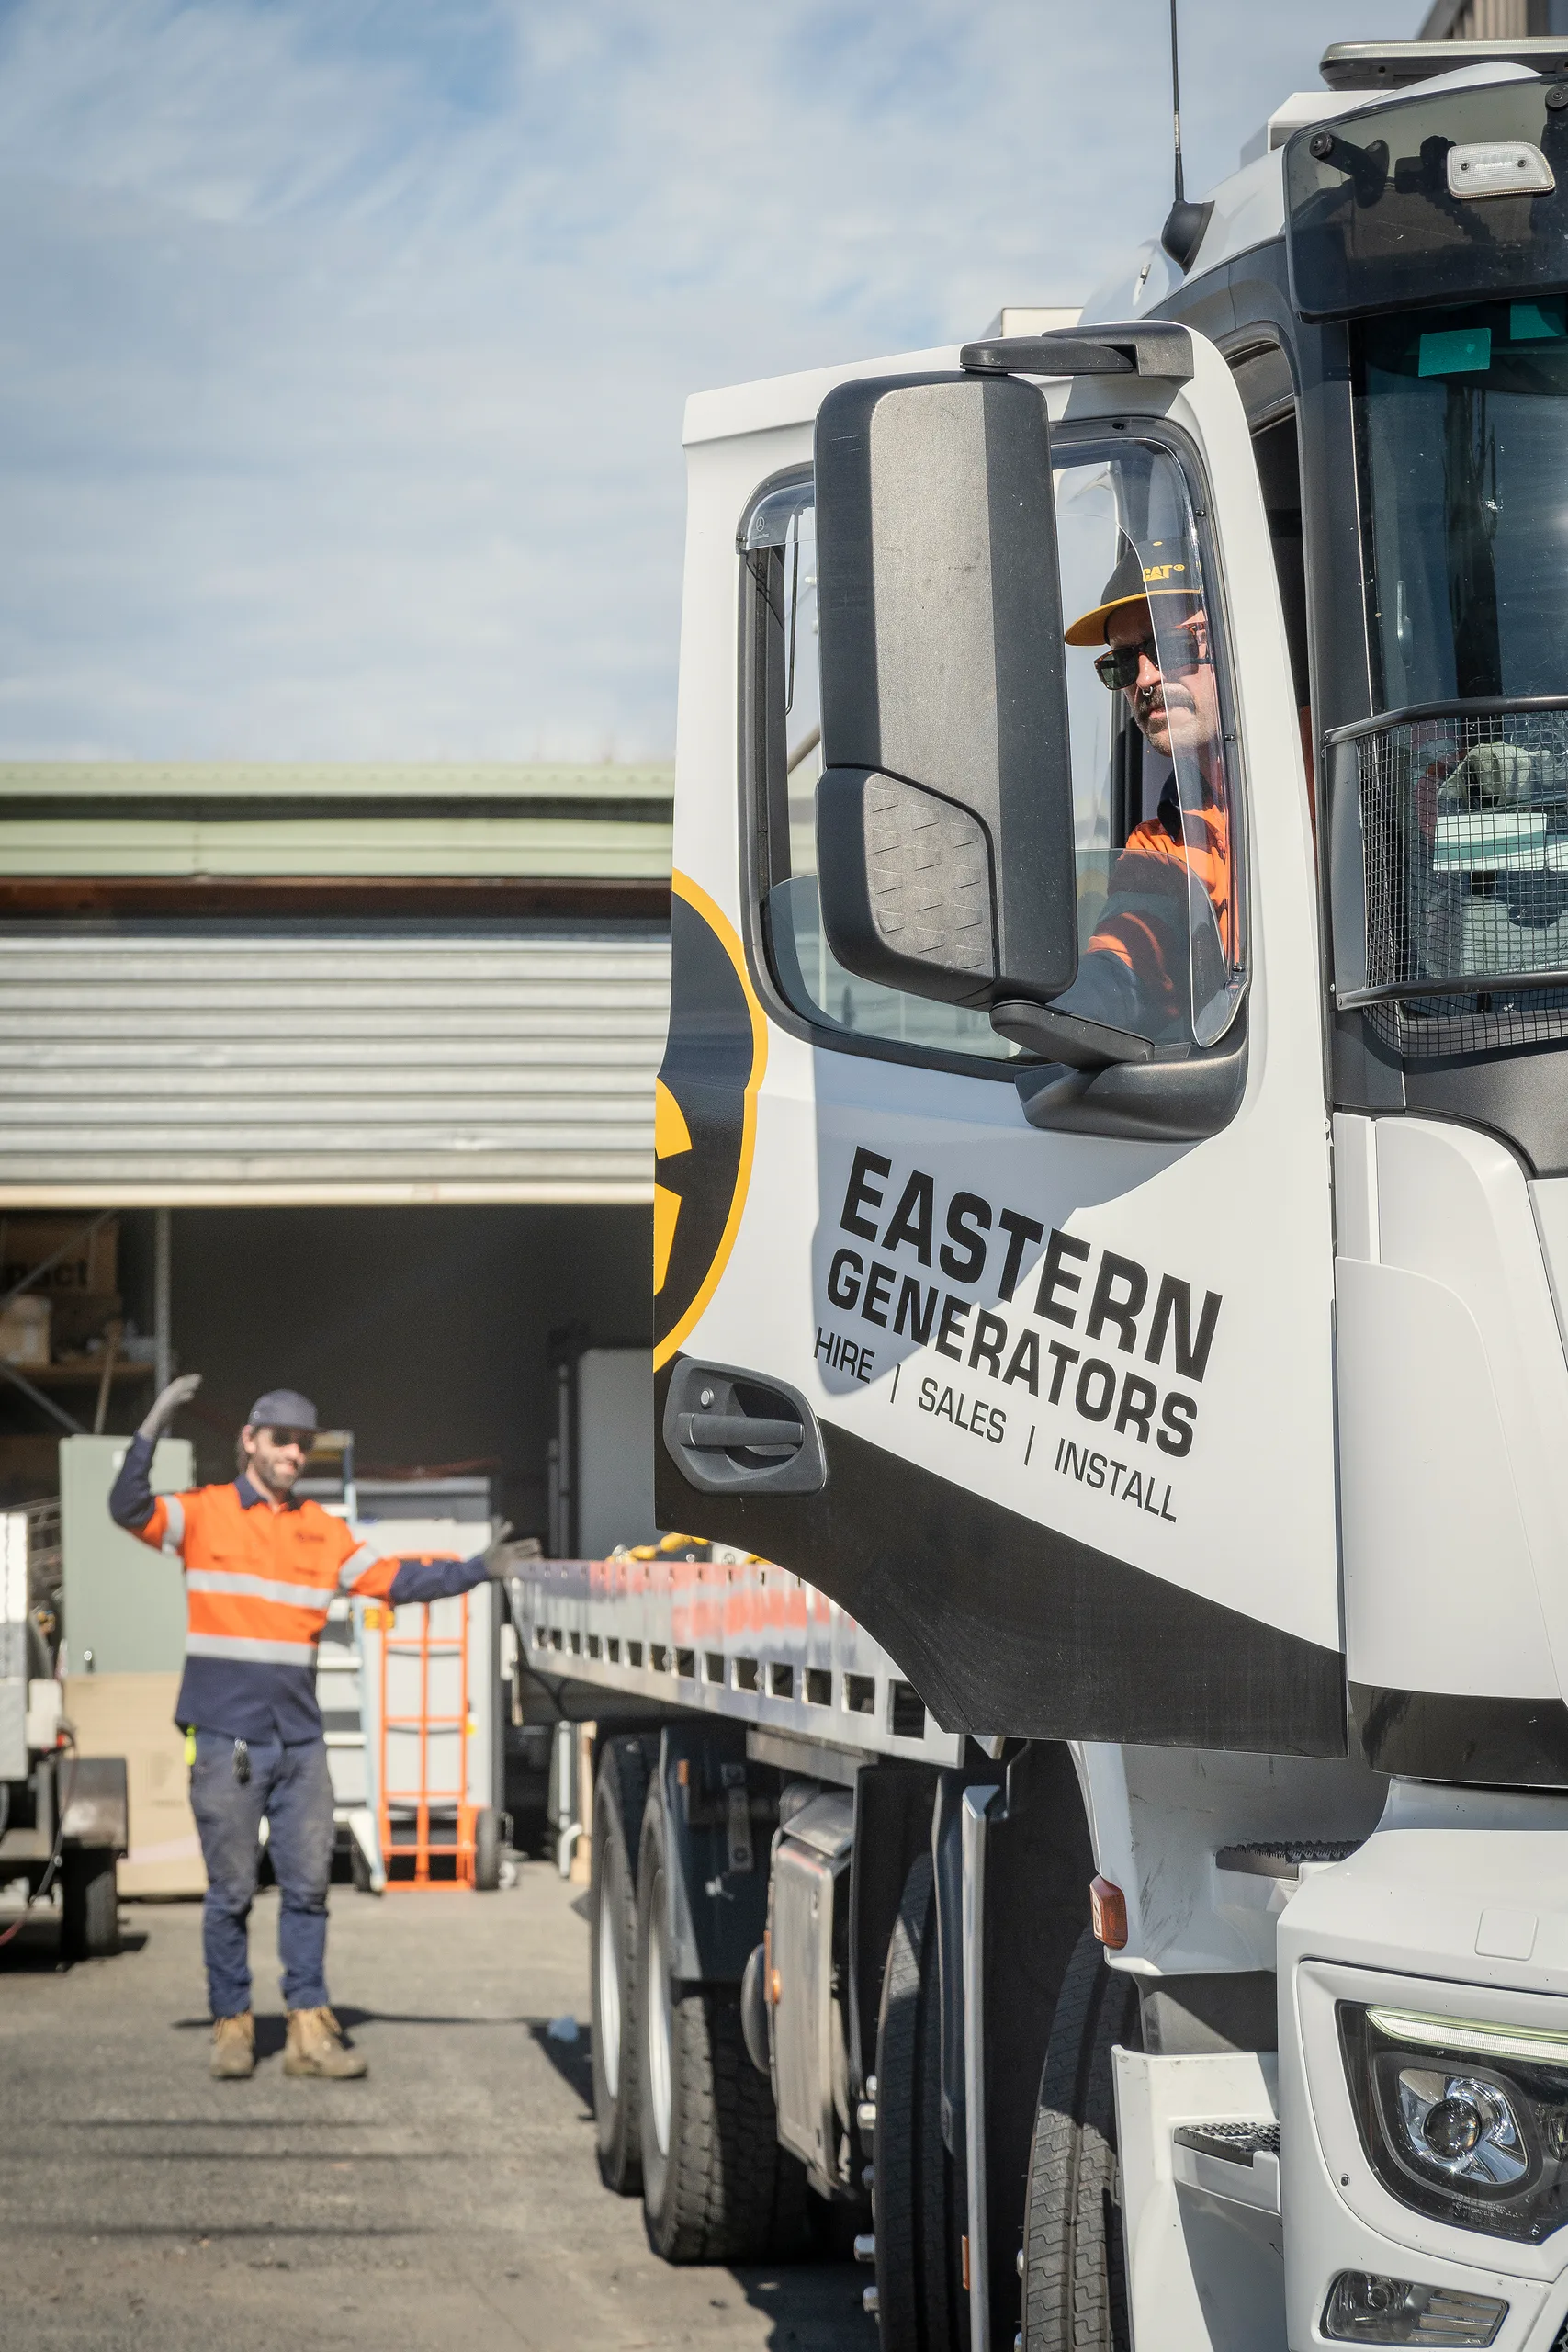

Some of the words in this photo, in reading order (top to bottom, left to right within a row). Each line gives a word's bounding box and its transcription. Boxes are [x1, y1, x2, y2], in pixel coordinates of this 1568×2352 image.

[828, 1249, 1198, 1458] GENERATORS
[840, 1146, 1223, 1383] EASTERN
[814, 1326, 875, 1385] HIRE
[919, 1377, 1007, 1444] SALES
[1055, 1438, 1177, 1523] INSTALL
